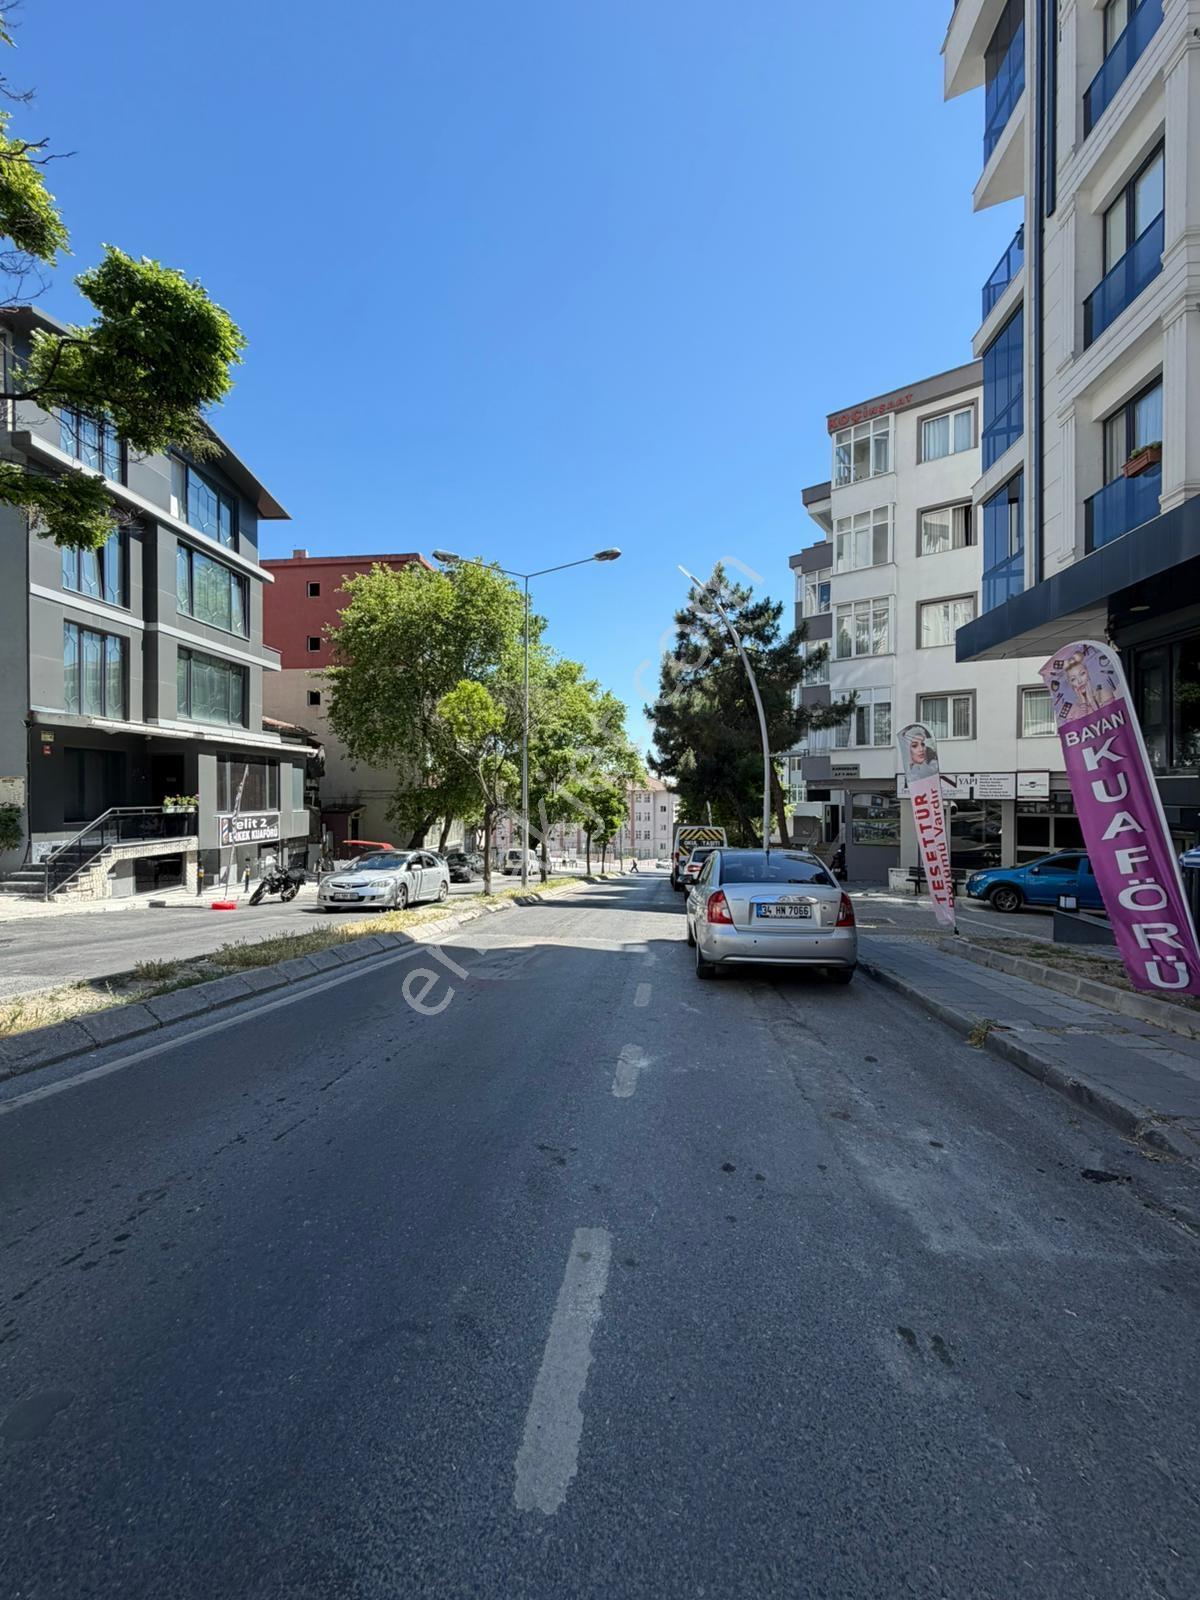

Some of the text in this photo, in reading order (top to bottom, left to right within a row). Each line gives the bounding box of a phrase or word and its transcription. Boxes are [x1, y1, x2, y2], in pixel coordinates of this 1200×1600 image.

[1065, 710, 1126, 747] BAYAN
[958, 777, 978, 785] YAPI
[236, 818, 268, 830] elit 2
[931, 788, 944, 838] Vardır
[252, 826, 278, 840] KUAFÖRÜ
[915, 793, 947, 905] TESETTÜR
[1082, 736, 1190, 989] KUAFÖRÜ
[762, 905, 809, 916] 34 HN 7066
